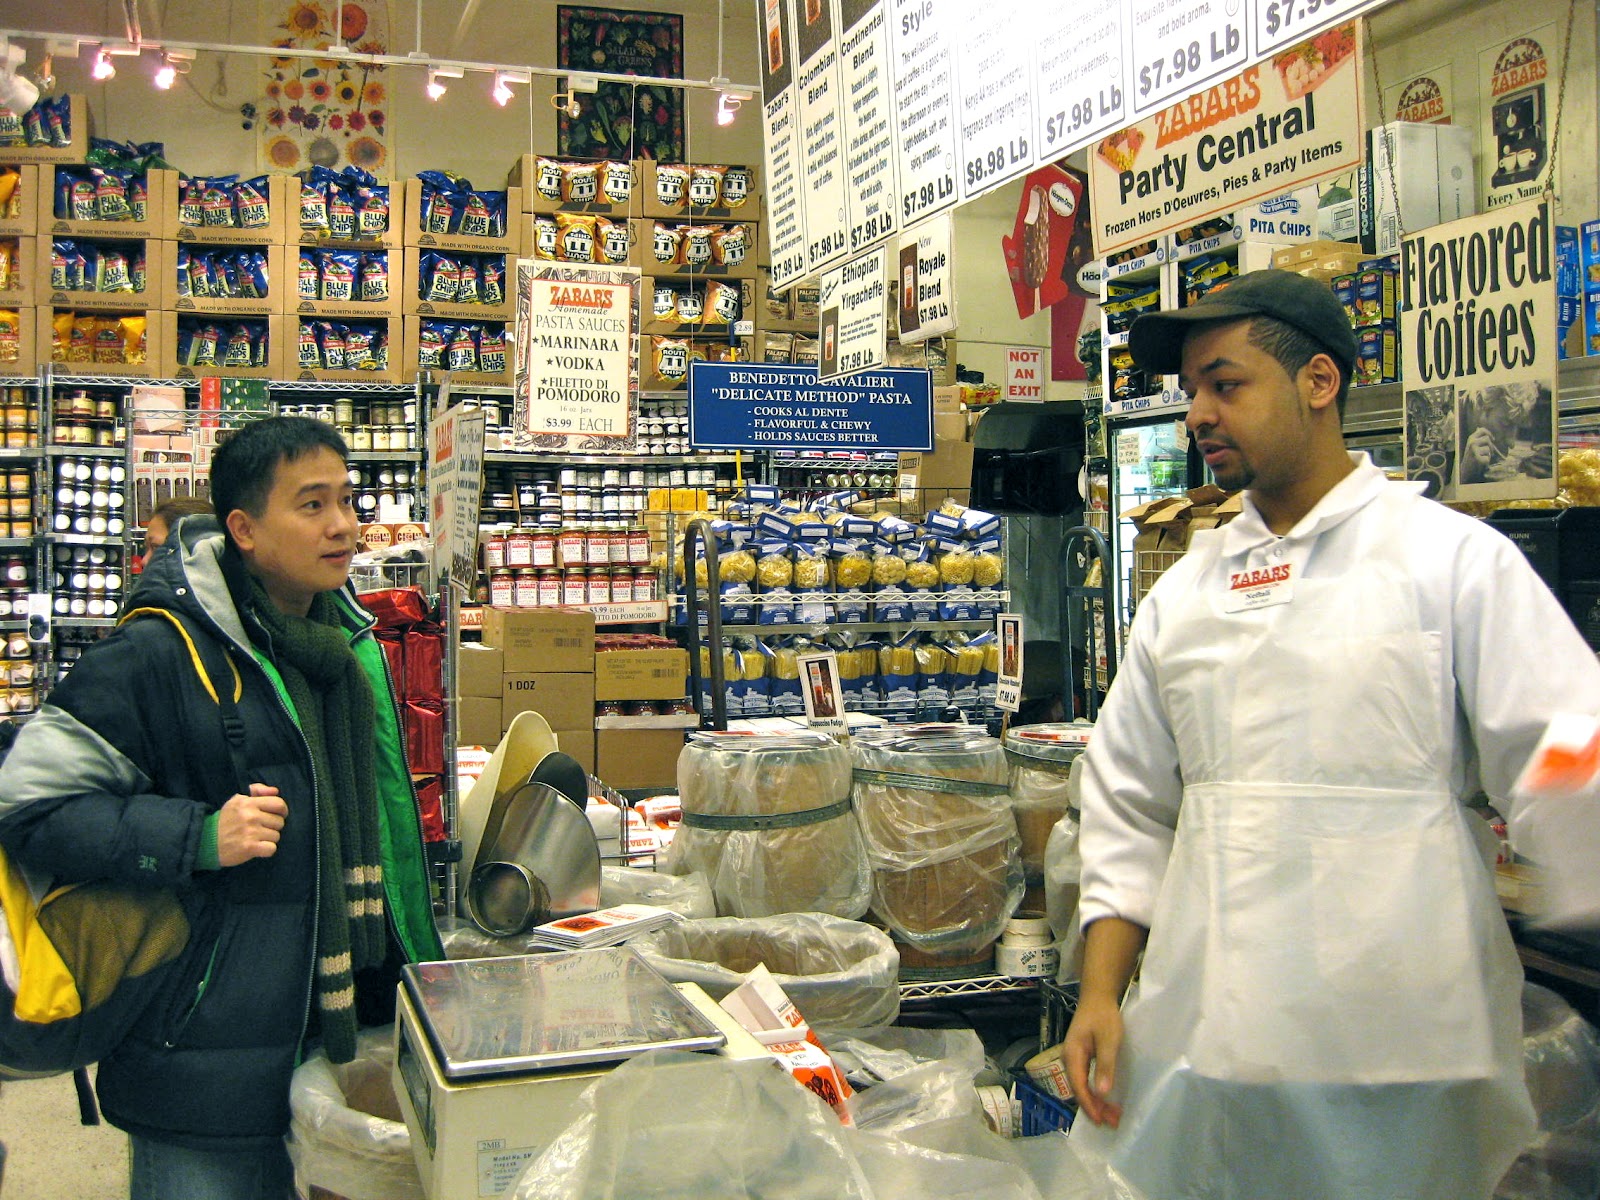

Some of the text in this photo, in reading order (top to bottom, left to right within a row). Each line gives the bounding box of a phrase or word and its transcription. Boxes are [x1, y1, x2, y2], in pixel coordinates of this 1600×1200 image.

[902, 1, 933, 36] Style
[1158, 26, 1169, 39] and
[1171, 13, 1185, 31] bold
[1266, 0, 1338, 37] $7.9
[842, 8, 884, 57] Continental
[853, 41, 874, 70] Blend
[1139, 24, 1240, 98] $7.98 Lb
[800, 52, 835, 90] Colombian
[808, 79, 828, 105] Blend
[767, 91, 788, 119] Zabar's
[1047, 84, 1121, 145] $7.98 Lb
[772, 112, 788, 136] Blend
[1119, 91, 1315, 205] Party Central
[967, 136, 1028, 188] $8.98 Lb
[610, 171, 629, 179] ROUTE
[658, 178, 682, 186] ROUTE
[612, 180, 625, 190] 11
[663, 185, 676, 194] 11
[1106, 140, 1343, 237] Frozen Hors D'Oeuvres, Pies & Party Items
[904, 174, 953, 218] $7.98 Lb
[1487, 184, 1543, 207] Every Name
[204, 209, 227, 219] BLUE
[242, 205, 265, 215] BLUE
[243, 212, 264, 223] CHIPS
[206, 216, 228, 226] CHIPS
[1250, 218, 1311, 237] PITA CHIPS
[851, 212, 892, 249] $7.98 Lb
[810, 230, 844, 265] $7.98 Lb
[1189, 238, 1220, 254] PITA CHIPS
[919, 251, 945, 277] Royale
[1401, 202, 1551, 312] Flavored
[774, 252, 803, 283] $7.98 Lb
[842, 256, 878, 285] Ethiopian
[1118, 259, 1145, 274] PITA CHIPS
[326, 282, 348, 290] BLUE
[326, 289, 348, 298] CHIPS
[919, 278, 941, 302] Blend
[842, 280, 882, 311] Yirgacheffe
[548, 298, 608, 316] Homemade
[920, 302, 948, 323] $7.98 Lb
[536, 315, 625, 332] PASTA SAUCES
[540, 335, 619, 351] MARINARA
[1417, 299, 1536, 383] Coffees
[482, 353, 505, 363] BLUE
[555, 356, 605, 371] VODKA
[666, 358, 680, 367] 11
[841, 349, 873, 372] $7.98 Lb
[1009, 351, 1038, 363] NOT
[483, 361, 505, 371] CHIPS
[1015, 369, 1034, 379] AN
[549, 377, 608, 390] FILETTO DI
[729, 372, 817, 386] BENEDETTO
[537, 387, 620, 403] POMODORO
[711, 387, 912, 405] "DELICATE METHOD" PASTA
[1009, 385, 1040, 397] EXIT
[1121, 398, 1150, 410] PITA CHIPS
[754, 407, 848, 418] COOKS AL DENTE
[546, 418, 613, 432] $3.99 EACH
[754, 419, 871, 431] FLAVORFUL & CHEWY
[754, 431, 879, 443] HOLDS SAUCES BETTER
[620, 612, 657, 621] POMODORO
[508, 681, 536, 691] 1 DOZ
[482, 1141, 500, 1150] 2MB
